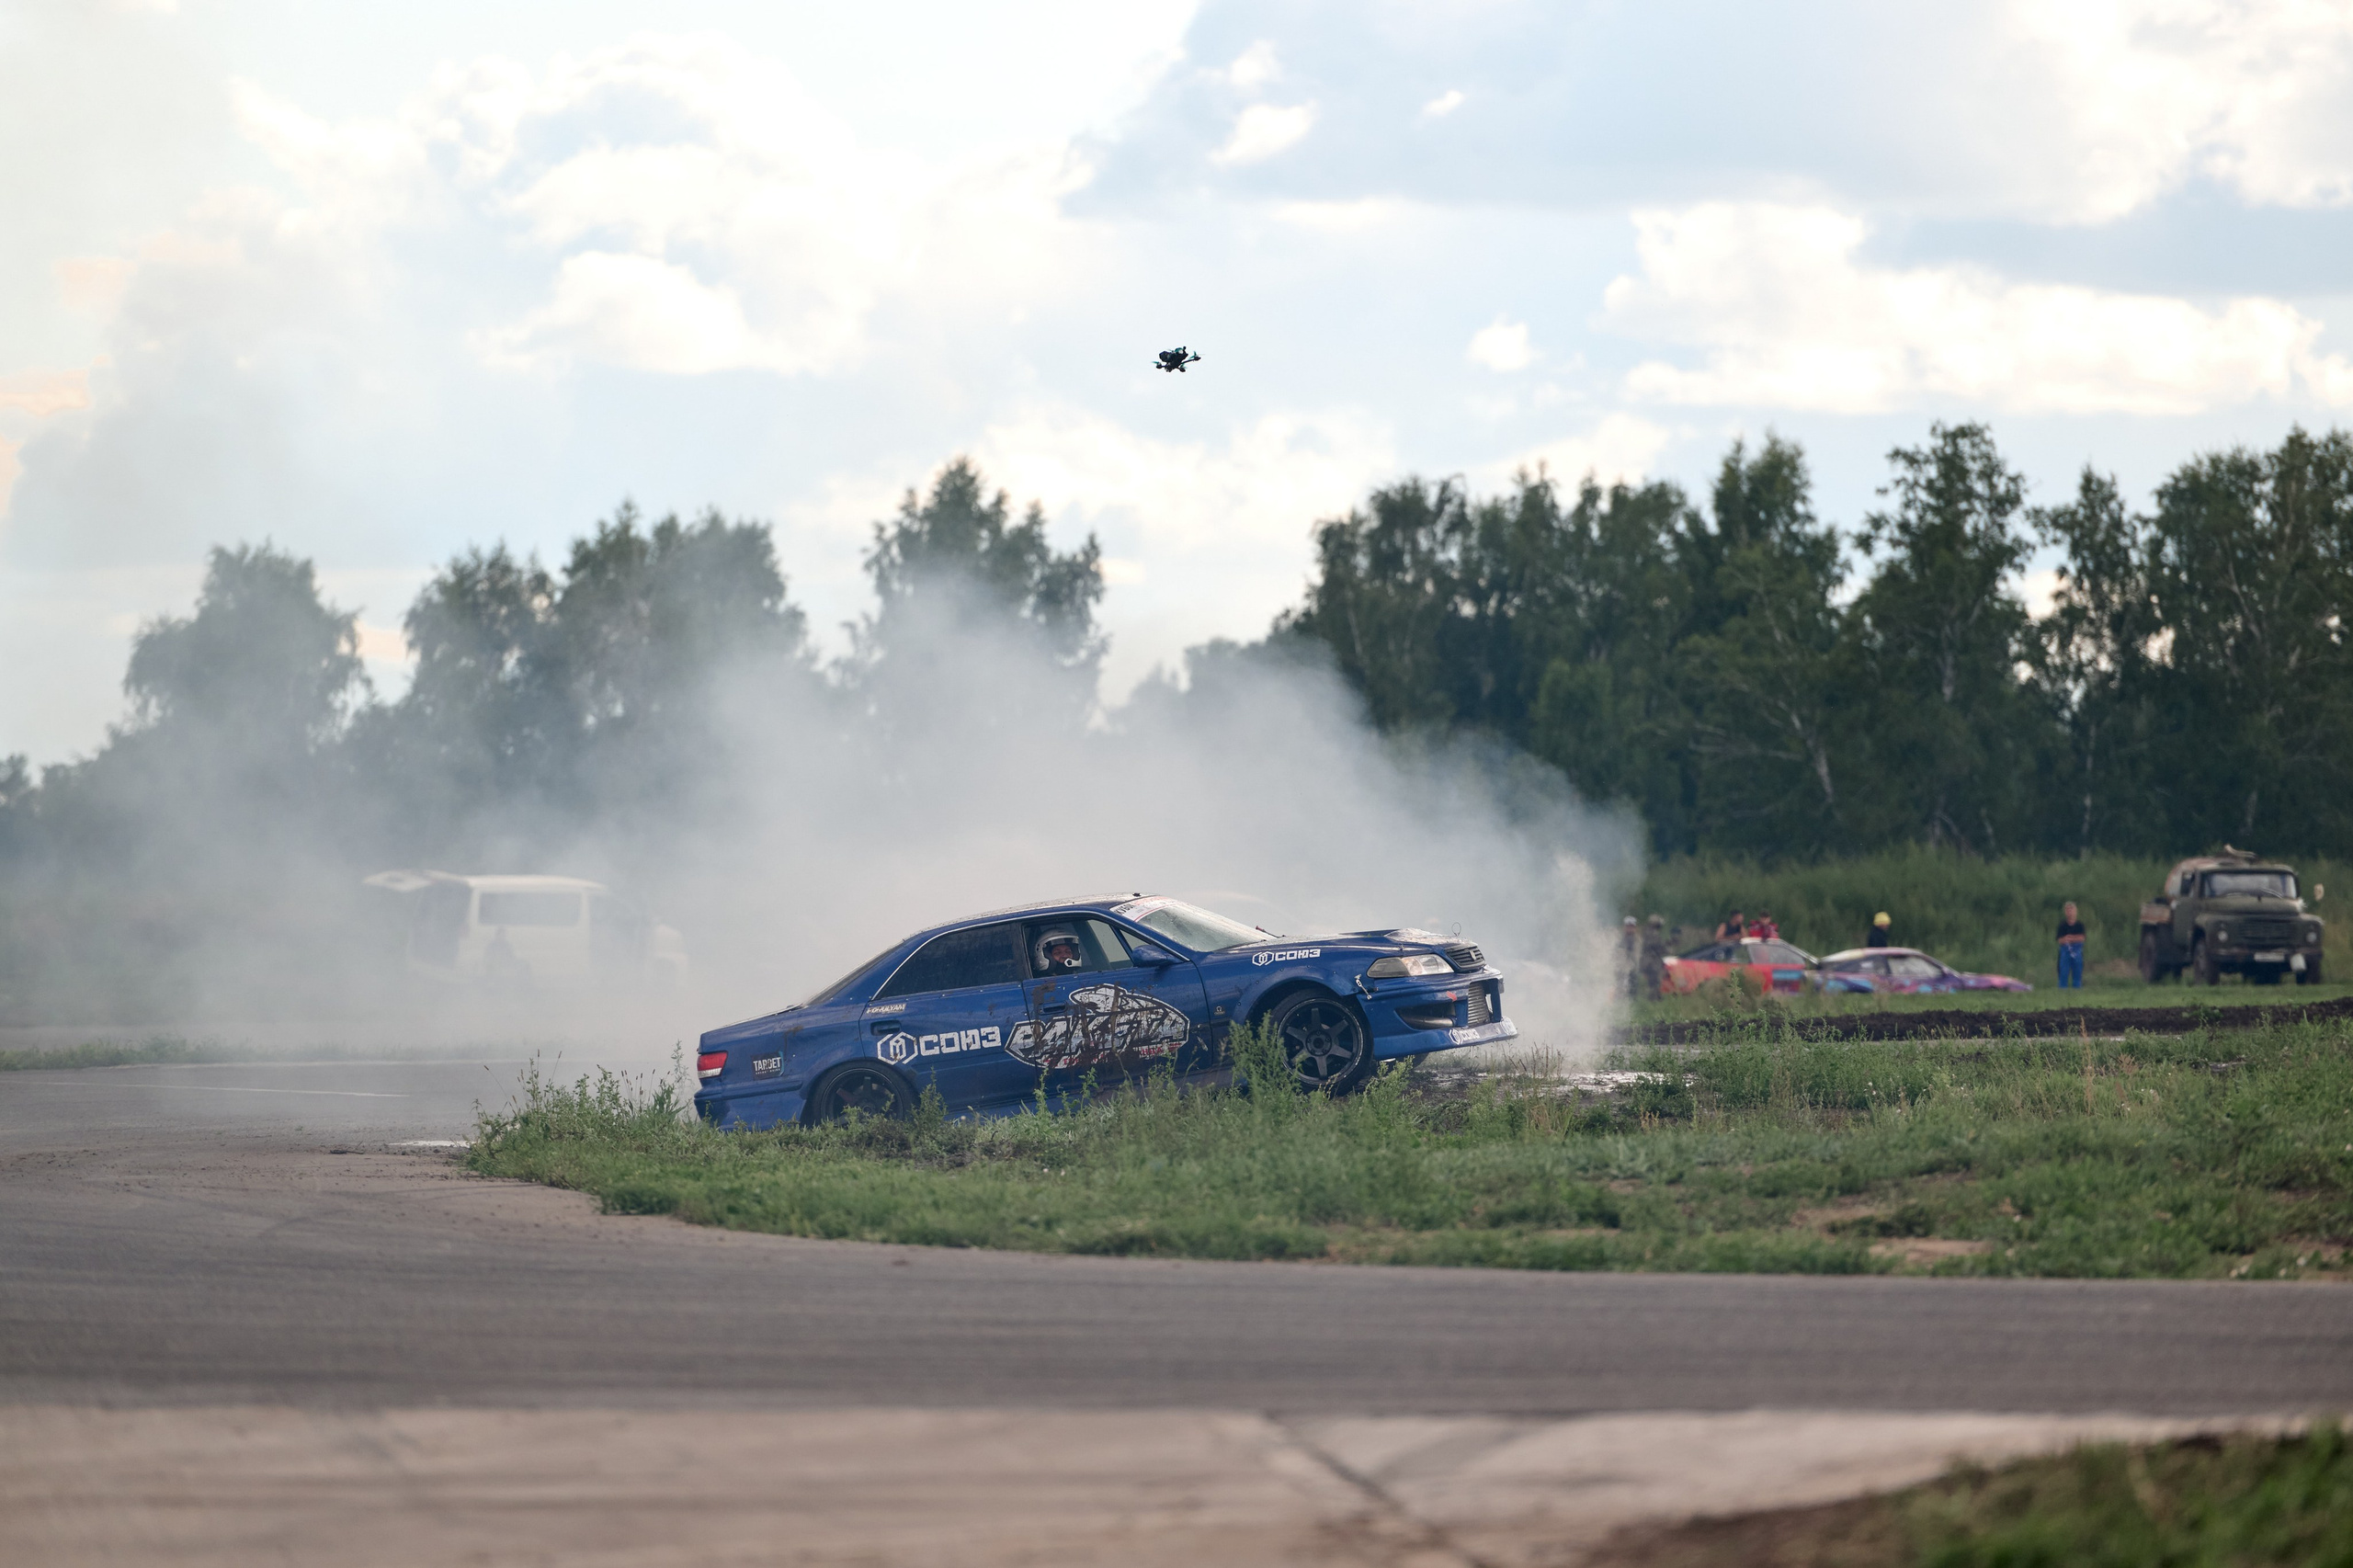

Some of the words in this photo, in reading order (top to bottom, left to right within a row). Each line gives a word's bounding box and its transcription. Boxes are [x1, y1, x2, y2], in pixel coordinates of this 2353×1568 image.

[1275, 949, 1321, 961] СОЮЗ
[919, 1026, 1002, 1056] СОЮЗ
[753, 1057, 781, 1072] TARGET
